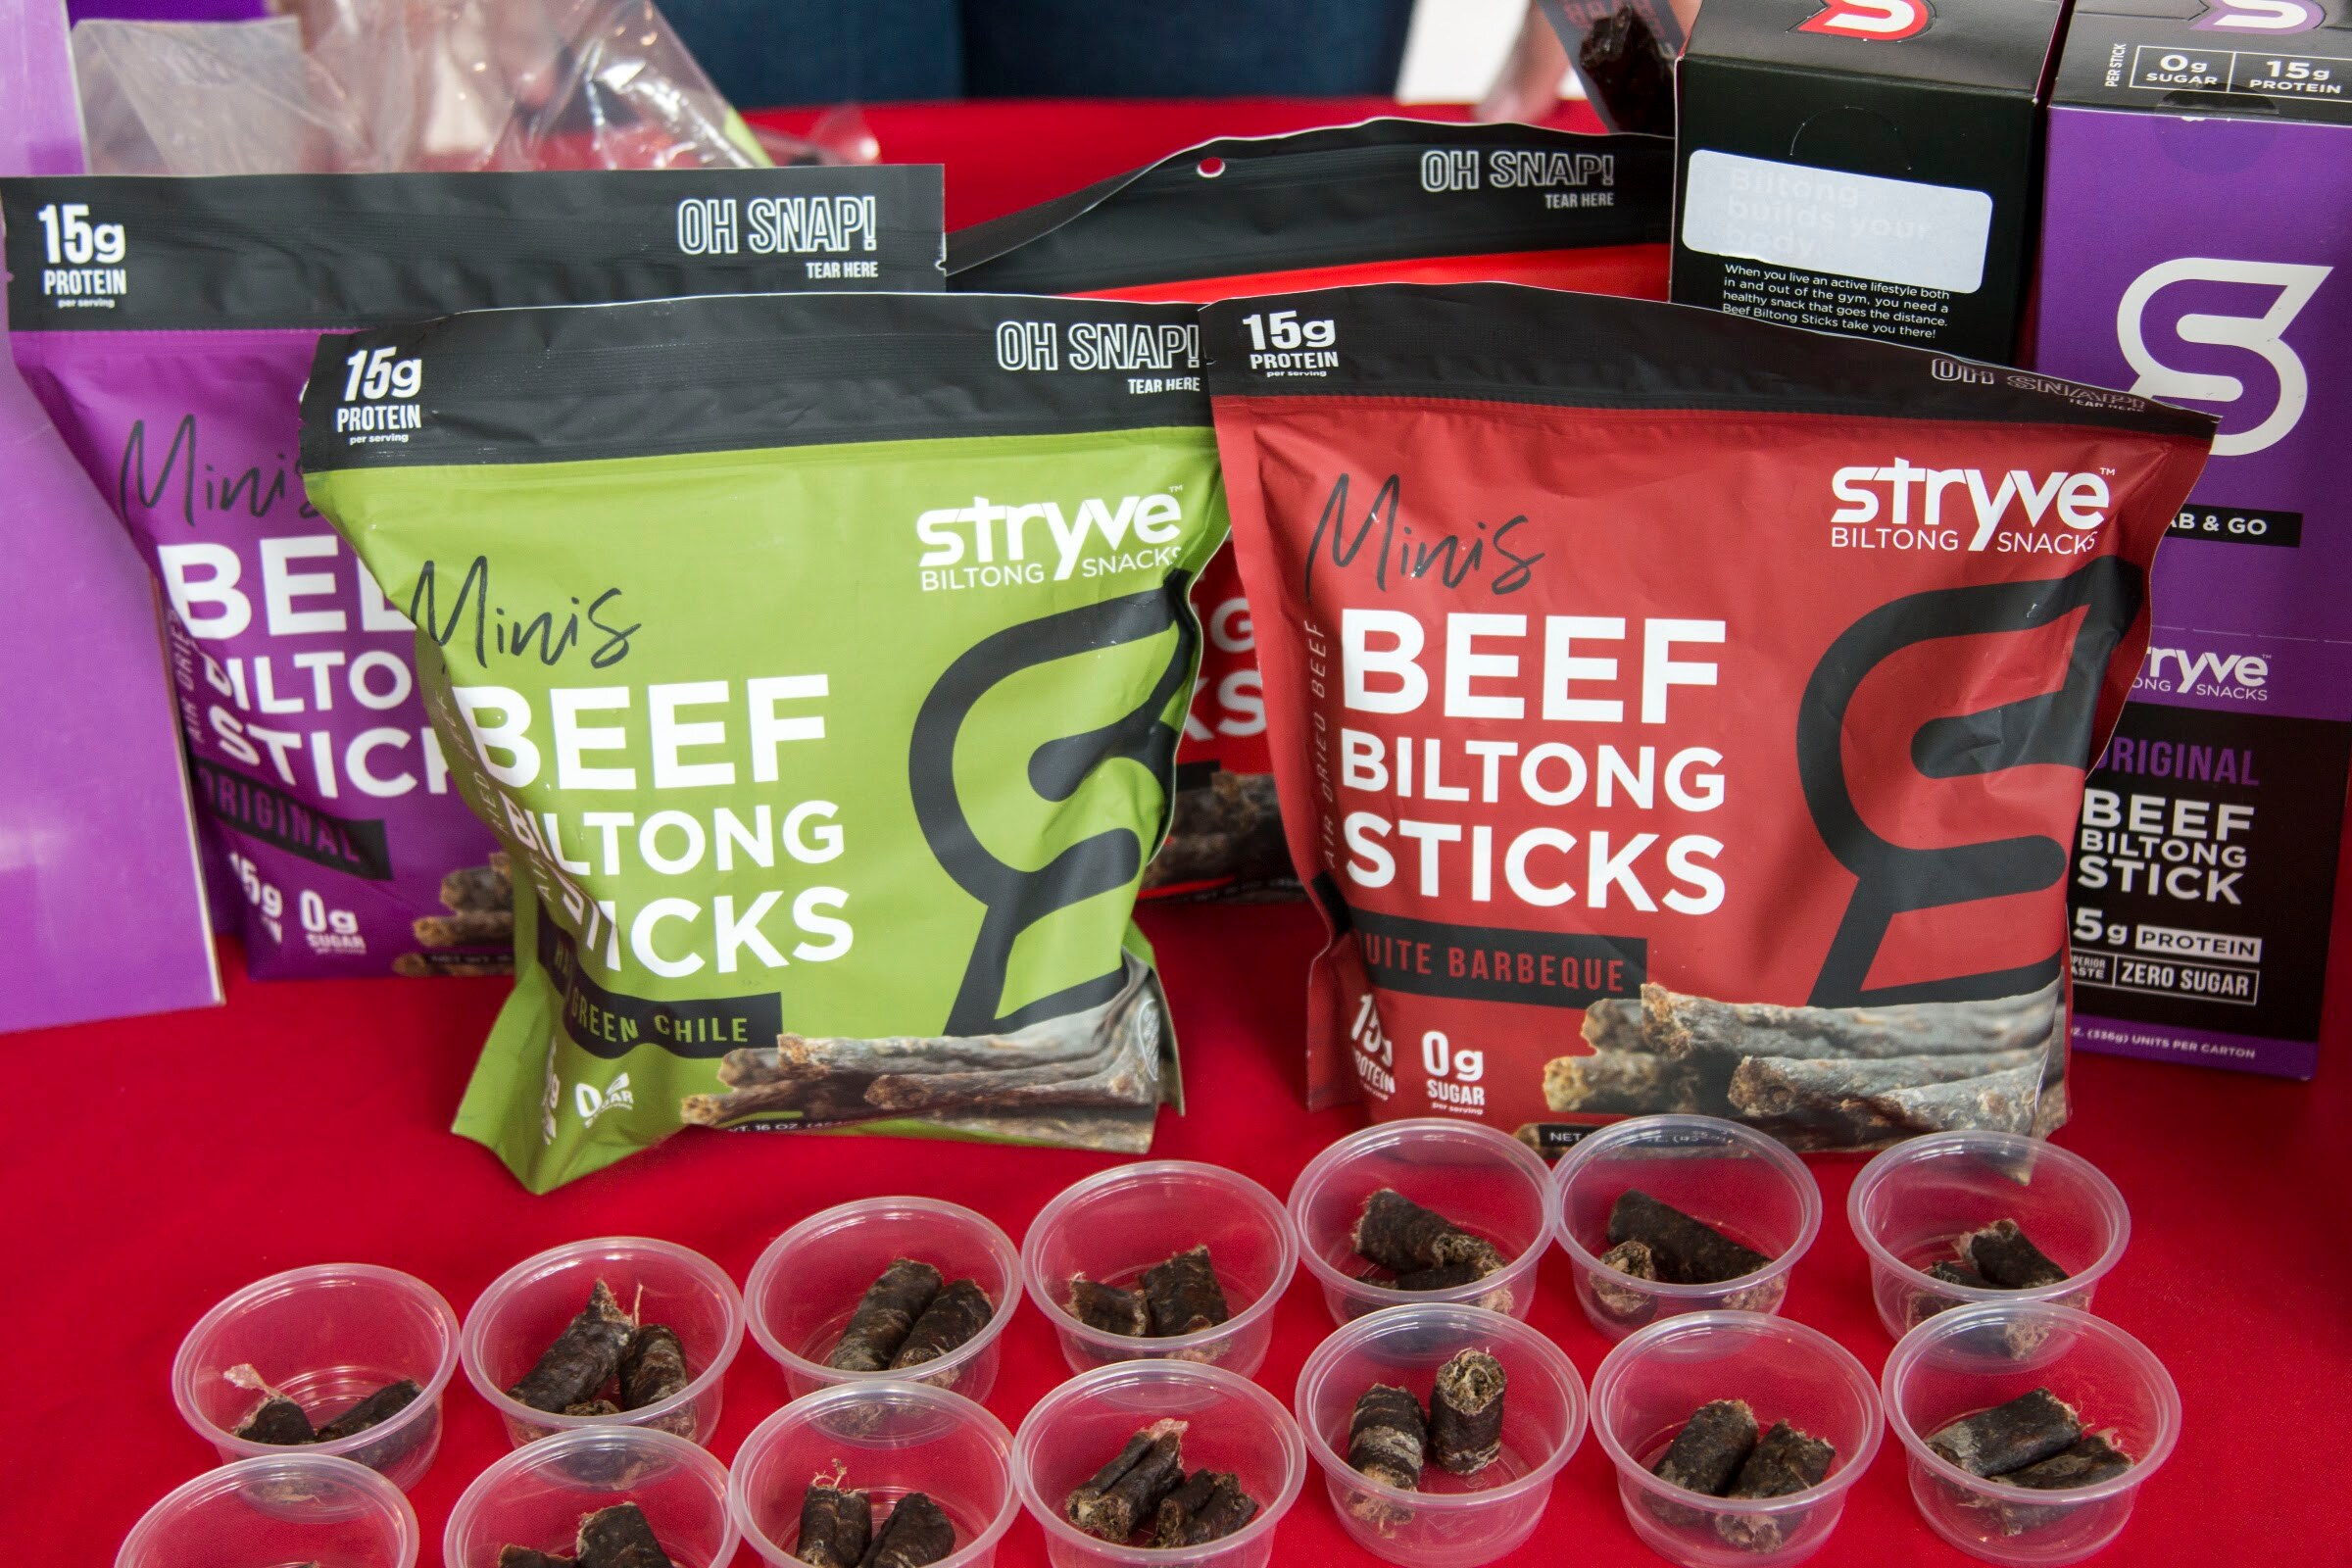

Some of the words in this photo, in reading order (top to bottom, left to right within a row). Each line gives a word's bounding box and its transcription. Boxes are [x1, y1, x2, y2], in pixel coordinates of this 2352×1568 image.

[2105, 69, 2121, 87] PER
[2114, 43, 2127, 69] STICK
[2146, 74, 2218, 85] SUGAR
[2160, 55, 2208, 74] 0g
[2266, 61, 2330, 80] 15g
[2250, 79, 2341, 94] PROTEIN
[1422, 150, 1479, 192] OH
[1490, 150, 1615, 188] SNAP!
[1544, 193, 1578, 209] TEAR
[1581, 192, 1614, 207] HERE
[38, 204, 126, 264] 15g
[677, 199, 737, 255] OH
[748, 196, 876, 252] SNAP!
[43, 269, 127, 295] PROTEIN
[807, 262, 841, 279] TEAR
[844, 261, 878, 278] HERE
[1725, 264, 1760, 276] When
[1764, 270, 1786, 280] you
[1789, 272, 1810, 283] live
[1812, 277, 1828, 286] an
[1831, 278, 1868, 290] active
[1870, 281, 1918, 297] lifestyle
[1921, 287, 1950, 300] both
[1723, 290, 1768, 306] healthy
[1771, 298, 1805, 310] snack
[1808, 301, 1834, 314] that
[1837, 307, 1867, 318] goes
[1870, 309, 1890, 320] the
[1892, 312, 1948, 326] distance.
[1724, 277, 1736, 287] in
[1740, 282, 1764, 291] and
[1768, 284, 1790, 294] out
[1794, 287, 1809, 296] of
[1812, 288, 1834, 300] the
[1875, 297, 1899, 308] you
[1903, 301, 1936, 312] need
[1940, 305, 1949, 314] a
[1242, 310, 1337, 351] 15g
[1723, 303, 1751, 316] Beef
[1753, 307, 1798, 323] Biltong
[1801, 314, 1838, 327] Sticks
[1841, 318, 1869, 331] take
[1872, 323, 1896, 334] you
[1899, 326, 1936, 339] there!
[997, 321, 1057, 371] OH
[1068, 323, 1200, 370] SNAP!
[1250, 351, 1340, 369] PROTEIN
[344, 346, 423, 402] 15g
[1128, 378, 1164, 395] TEAR
[1166, 376, 1200, 393] HERE
[1932, 358, 1994, 384] OH
[337, 404, 421, 433] PROTEIN
[349, 436, 368, 447] per
[368, 433, 410, 444] serving
[1831, 457, 2110, 551] stryve
[916, 496, 1182, 581] stryve
[1305, 472, 1545, 604] Minis
[1832, 527, 1959, 552] BILTONG
[1997, 530, 2098, 556] SNACKS
[2203, 514, 2220, 531] &
[2228, 517, 2268, 535] GO
[921, 563, 1045, 592] BILTONG
[411, 555, 642, 673] Minis
[1304, 619, 1327, 699] BEEF
[1342, 608, 1726, 724] BEEF
[2146, 646, 2269, 693] ryve
[199, 650, 413, 713] BILTO
[2196, 684, 2268, 701] SNACKS
[208, 705, 451, 799] STIC
[452, 674, 829, 790] BEEF
[1342, 727, 1726, 812] BILTONG
[498, 790, 845, 877] BILTONG
[2082, 788, 2255, 841] BEEF
[1343, 810, 1726, 915] STICKS
[2081, 828, 2247, 868] BILTONG
[2077, 855, 2244, 906] STICK
[300, 888, 360, 935] 0g
[2073, 906, 2129, 946] 5g
[2141, 931, 2255, 956] PROTEIN
[1448, 947, 1624, 993] BARBEQUE
[2071, 955, 2106, 969] PERIOR
[2071, 964, 2105, 979] ASTE
[2121, 961, 2175, 988] ZERO
[2180, 969, 2249, 998] SUGAR
[570, 986, 639, 1043] GREEN
[655, 1014, 748, 1044] CHILE
[1422, 1030, 1484, 1082] 0g
[2132, 1034, 2170, 1049] UNITS
[2173, 1040, 2198, 1052] PER
[2200, 1043, 2256, 1059] CARTON
[1426, 1078, 1486, 1106] SUGAR
[1432, 1102, 1448, 1110] per
[1449, 1105, 1484, 1116] serving
[1549, 1132, 1583, 1142] NET
